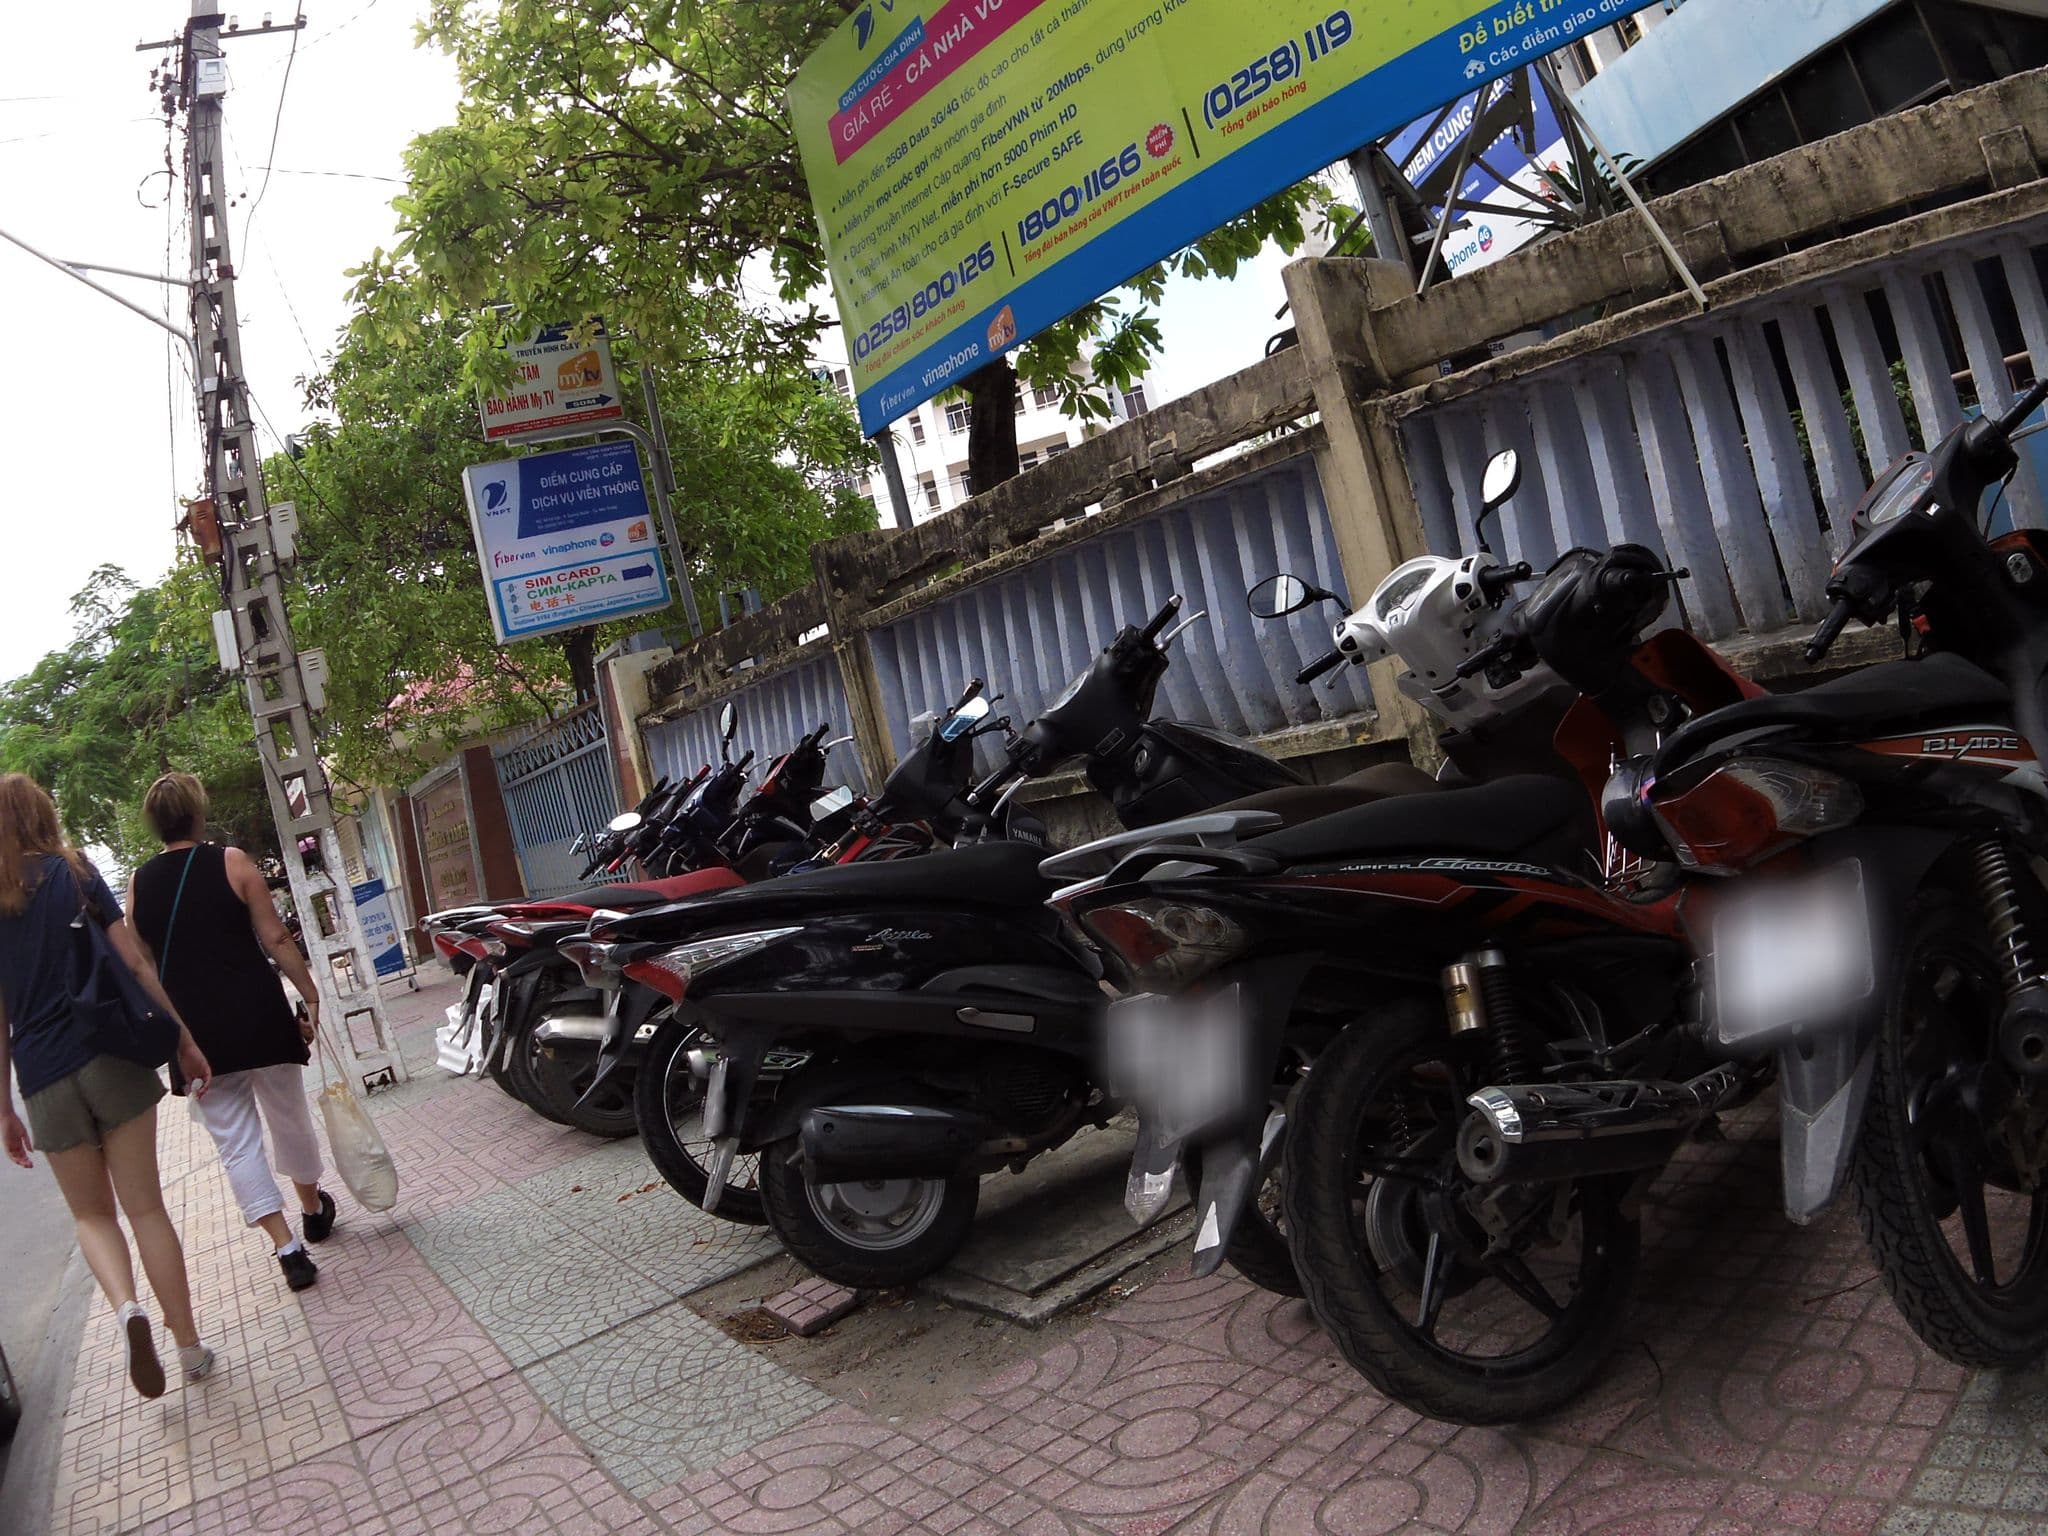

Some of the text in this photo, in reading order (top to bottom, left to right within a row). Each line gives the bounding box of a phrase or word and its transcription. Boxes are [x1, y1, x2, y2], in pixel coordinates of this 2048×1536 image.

[1458, 20, 1488, 54] Để
[1493, 0, 1537, 37] biết
[1488, 42, 1519, 67] Các
[1522, 26, 1560, 51] điểm
[1562, 8, 1597, 34] giao
[883, 51, 899, 67] GIA
[1203, 9, 1353, 130] (0258) 119
[842, 107, 870, 142] GIÁ
[870, 83, 894, 117] RẺ
[905, 49, 932, 84] CẢ
[933, 13, 976, 60] NHÀ
[885, 142, 909, 169] 25GB
[909, 125, 930, 148] Data
[930, 98, 960, 130] 3G/4G
[991, 60, 1009, 80] cao
[1010, 43, 1030, 65] cho
[900, 185, 933, 216] Internet
[981, 106, 1031, 153] FiberVNN
[1095, 36, 1126, 66] dung
[1125, 8, 1163, 43] lượng
[970, 114, 985, 134] gia
[1434, 104, 1473, 152] CUNG
[898, 223, 922, 248] MyTV
[1004, 139, 1028, 166] 5000
[1028, 120, 1058, 148] Phim
[1058, 103, 1079, 126] HD
[861, 278, 890, 305] Internet
[921, 239, 937, 259] cho
[949, 220, 965, 239] gia
[1002, 155, 1050, 197] F-Secure
[1050, 129, 1084, 162] SAFE
[1102, 191, 1123, 213] VNPT
[852, 301, 911, 366] (0258)
[922, 342, 980, 388] vinaphone
[543, 389, 555, 406] TV
[540, 460, 624, 489] ĐIỂM CUNG CẤP
[485, 506, 512, 518] VNPT
[531, 495, 559, 513] DỊCH
[559, 492, 574, 507] VỤ
[602, 479, 640, 497] THÔNG
[541, 536, 598, 556] vinaphone
[525, 565, 602, 590] SIM CARD
[526, 573, 618, 600] СИМ-КАРТА
[529, 593, 576, 612] 电话卡
[1922, 735, 2020, 760] BLADE
